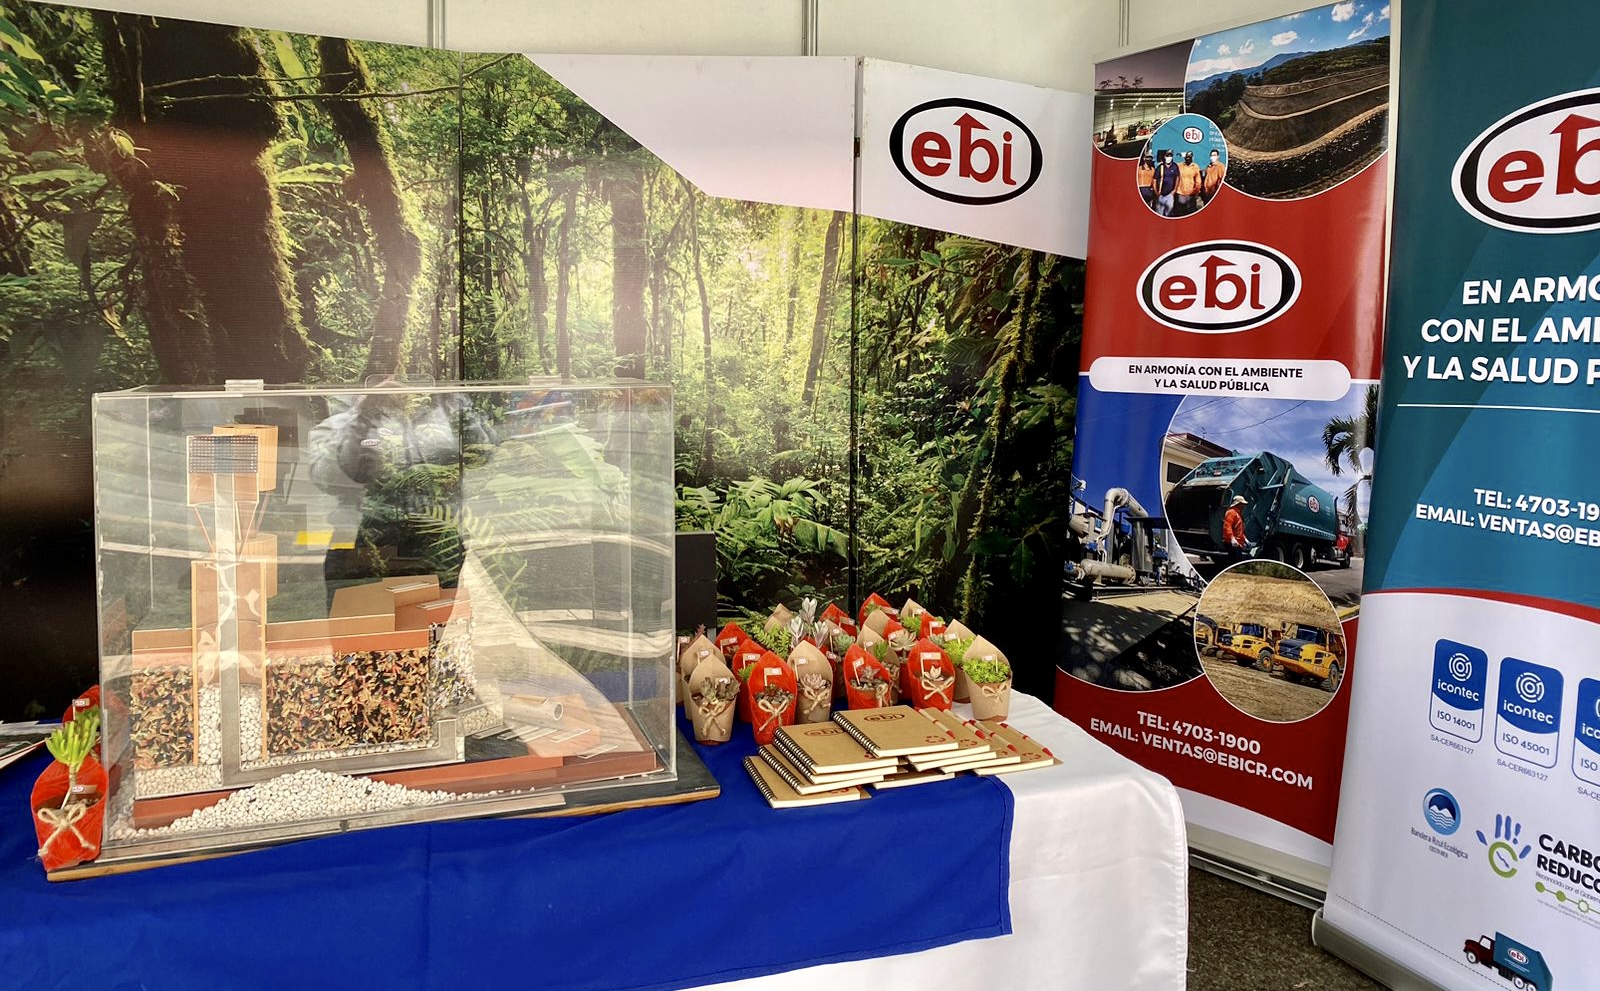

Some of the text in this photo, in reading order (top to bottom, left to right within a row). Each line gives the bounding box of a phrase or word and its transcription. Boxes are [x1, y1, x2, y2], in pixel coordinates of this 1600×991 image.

[911, 113, 1017, 186] ebi
[1159, 255, 1266, 311] ebi
[1463, 279, 1502, 305] EN
[1421, 318, 1485, 343] CON
[1491, 318, 1527, 343] EL
[1128, 363, 1303, 379] EN ARMONÍA CON EL AMBIENTE
[1403, 356, 1422, 379] Y
[1427, 356, 1464, 381] LA
[1470, 357, 1579, 384] SALUD
[1154, 378, 1270, 392] Y LA SALUD PÚBLICA
[1474, 488, 1600, 522] TEL: 4703-19
[1415, 503, 1600, 547] EMAIL: VENTAS@EB
[1437, 679, 1480, 702] icontec
[1437, 710, 1476, 731] ISO 14001
[1503, 700, 1554, 725] icontec
[1137, 711, 1261, 755] TEL: 4703-1900
[1502, 733, 1550, 756] ISO 45001
[1090, 717, 1313, 790] EMAIL: VENTAS@EBICR.COM
[1581, 758, 1599, 772] ISO
